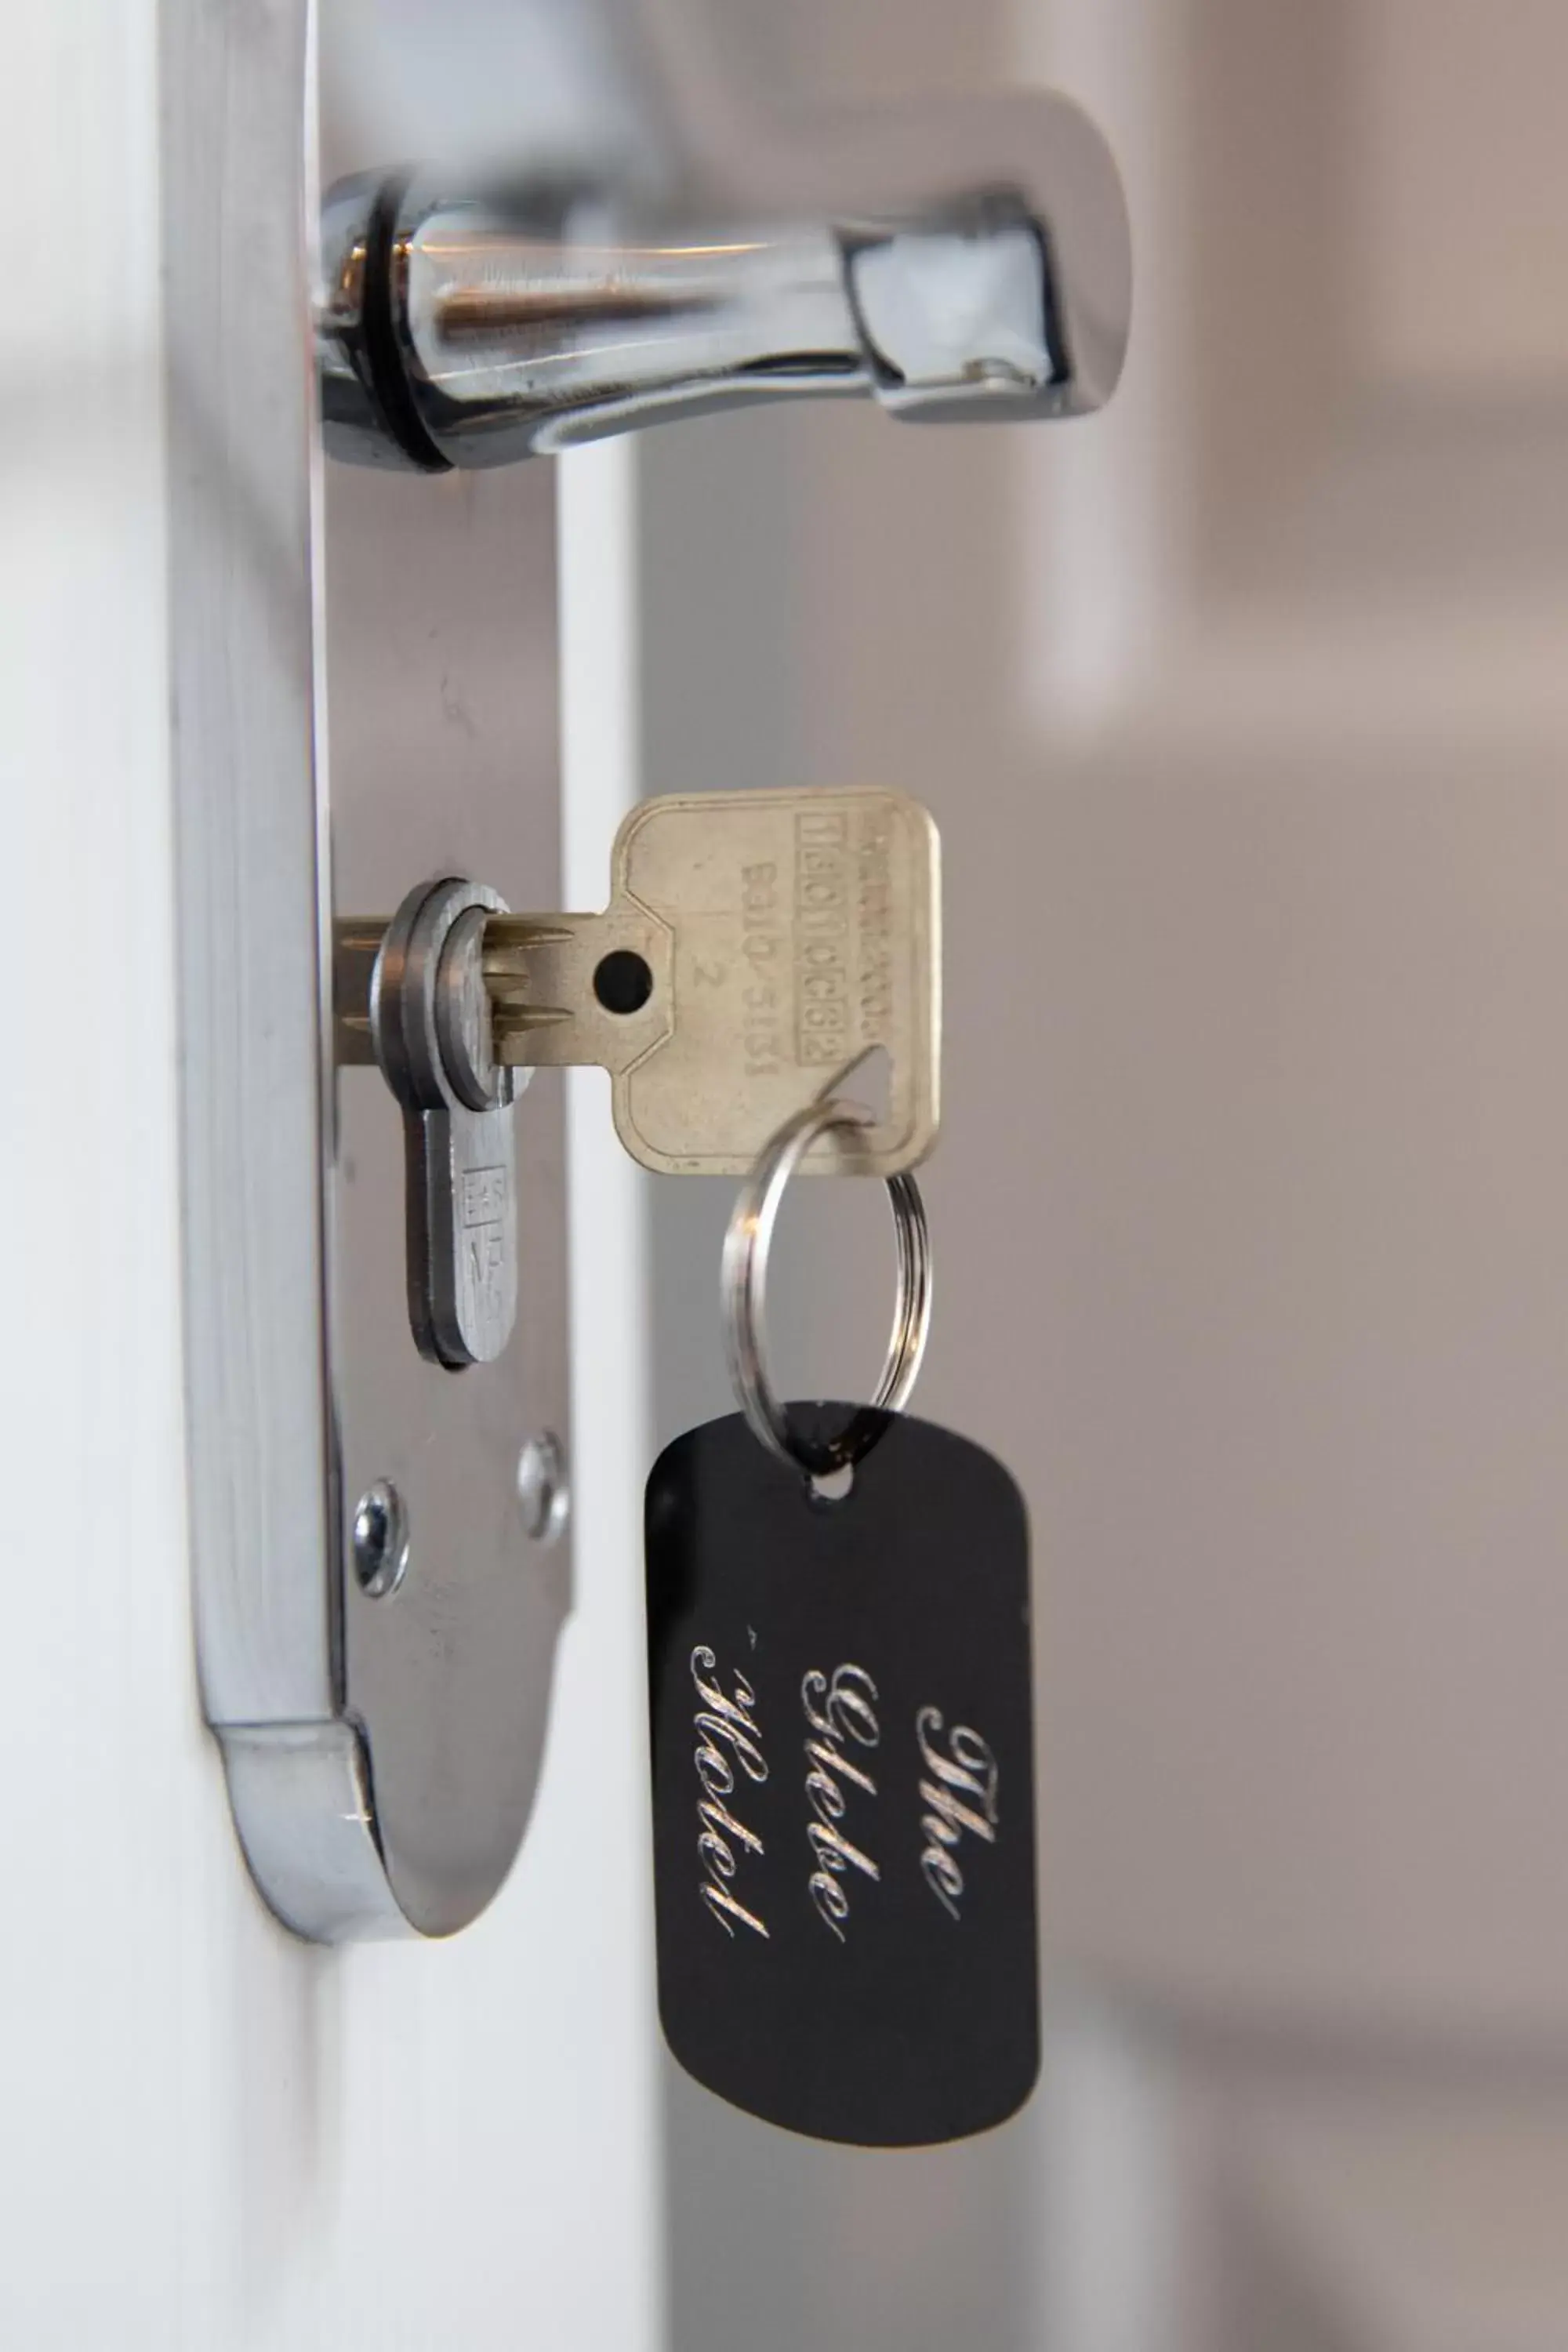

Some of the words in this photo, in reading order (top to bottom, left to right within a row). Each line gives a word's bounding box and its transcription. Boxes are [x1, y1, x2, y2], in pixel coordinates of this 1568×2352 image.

[691, 1646, 770, 1938] Hotel
[801, 1664, 880, 1943] Glebe
[916, 1706, 999, 1921] The
